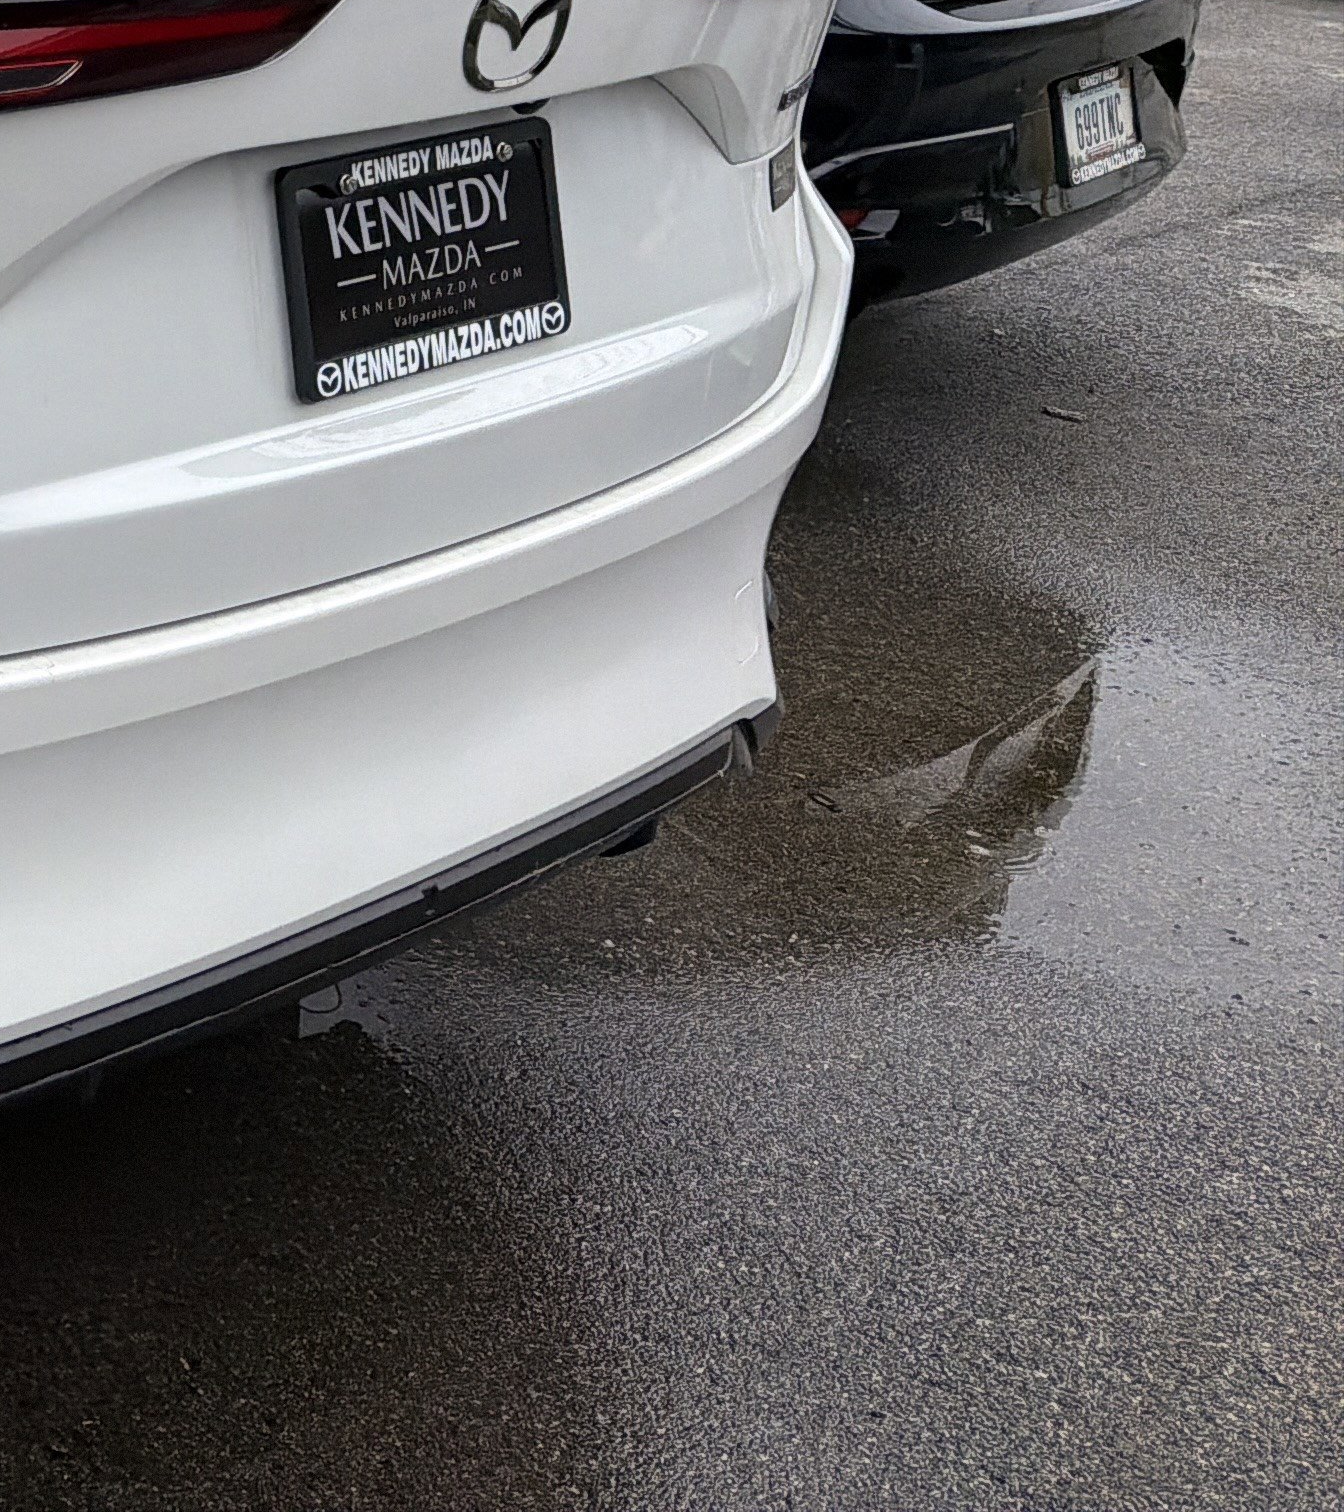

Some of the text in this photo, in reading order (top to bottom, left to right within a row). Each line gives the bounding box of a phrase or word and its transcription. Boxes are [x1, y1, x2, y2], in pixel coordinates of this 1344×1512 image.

[350, 136, 494, 188] KENNEDY MAZDA
[325, 169, 510, 259] KENNEDY
[382, 239, 482, 290] MAZDA
[393, 296, 477, 329] Valparaiso, IN
[342, 306, 542, 393] KENNEDYMAZDA.COM
